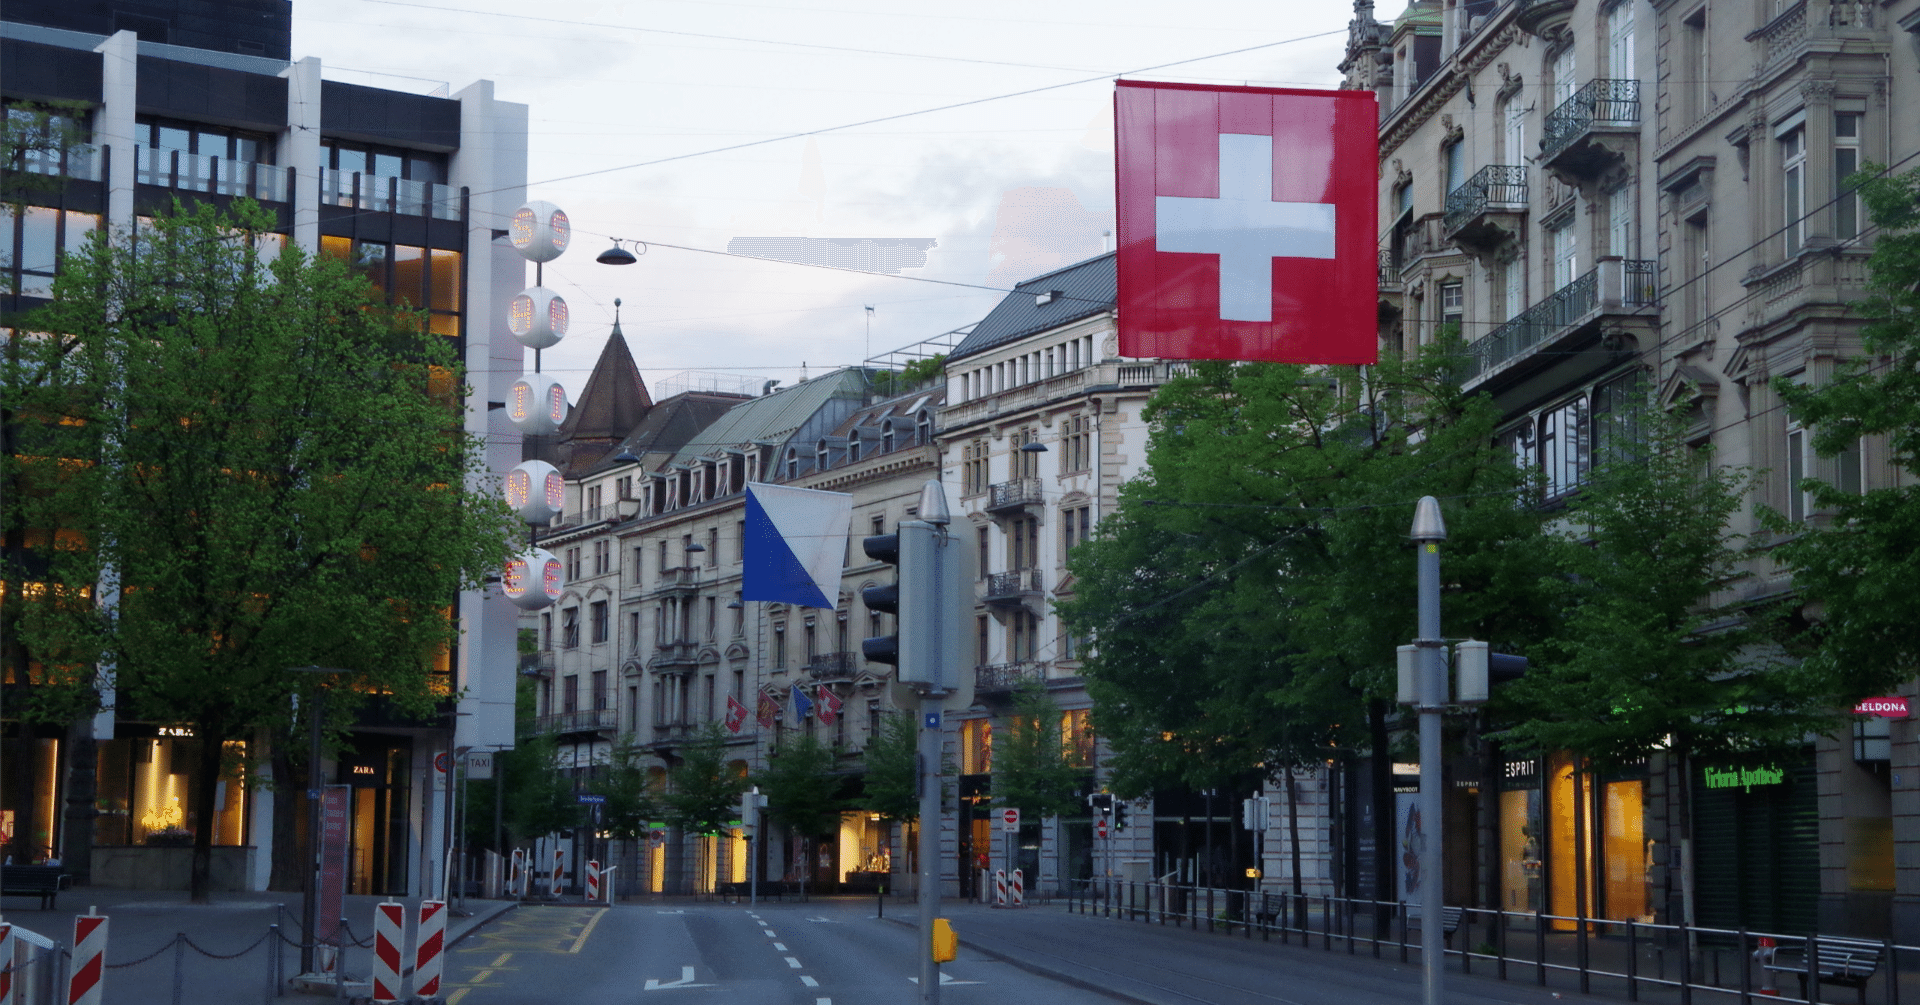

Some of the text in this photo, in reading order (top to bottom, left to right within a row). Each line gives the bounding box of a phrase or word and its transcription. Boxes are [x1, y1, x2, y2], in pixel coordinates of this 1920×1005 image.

[470, 758, 490, 767] TAXI
[1505, 759, 1535, 778] ESPRIT
[353, 765, 375, 775] ZARA
[1704, 764, 1738, 788] Victoria
